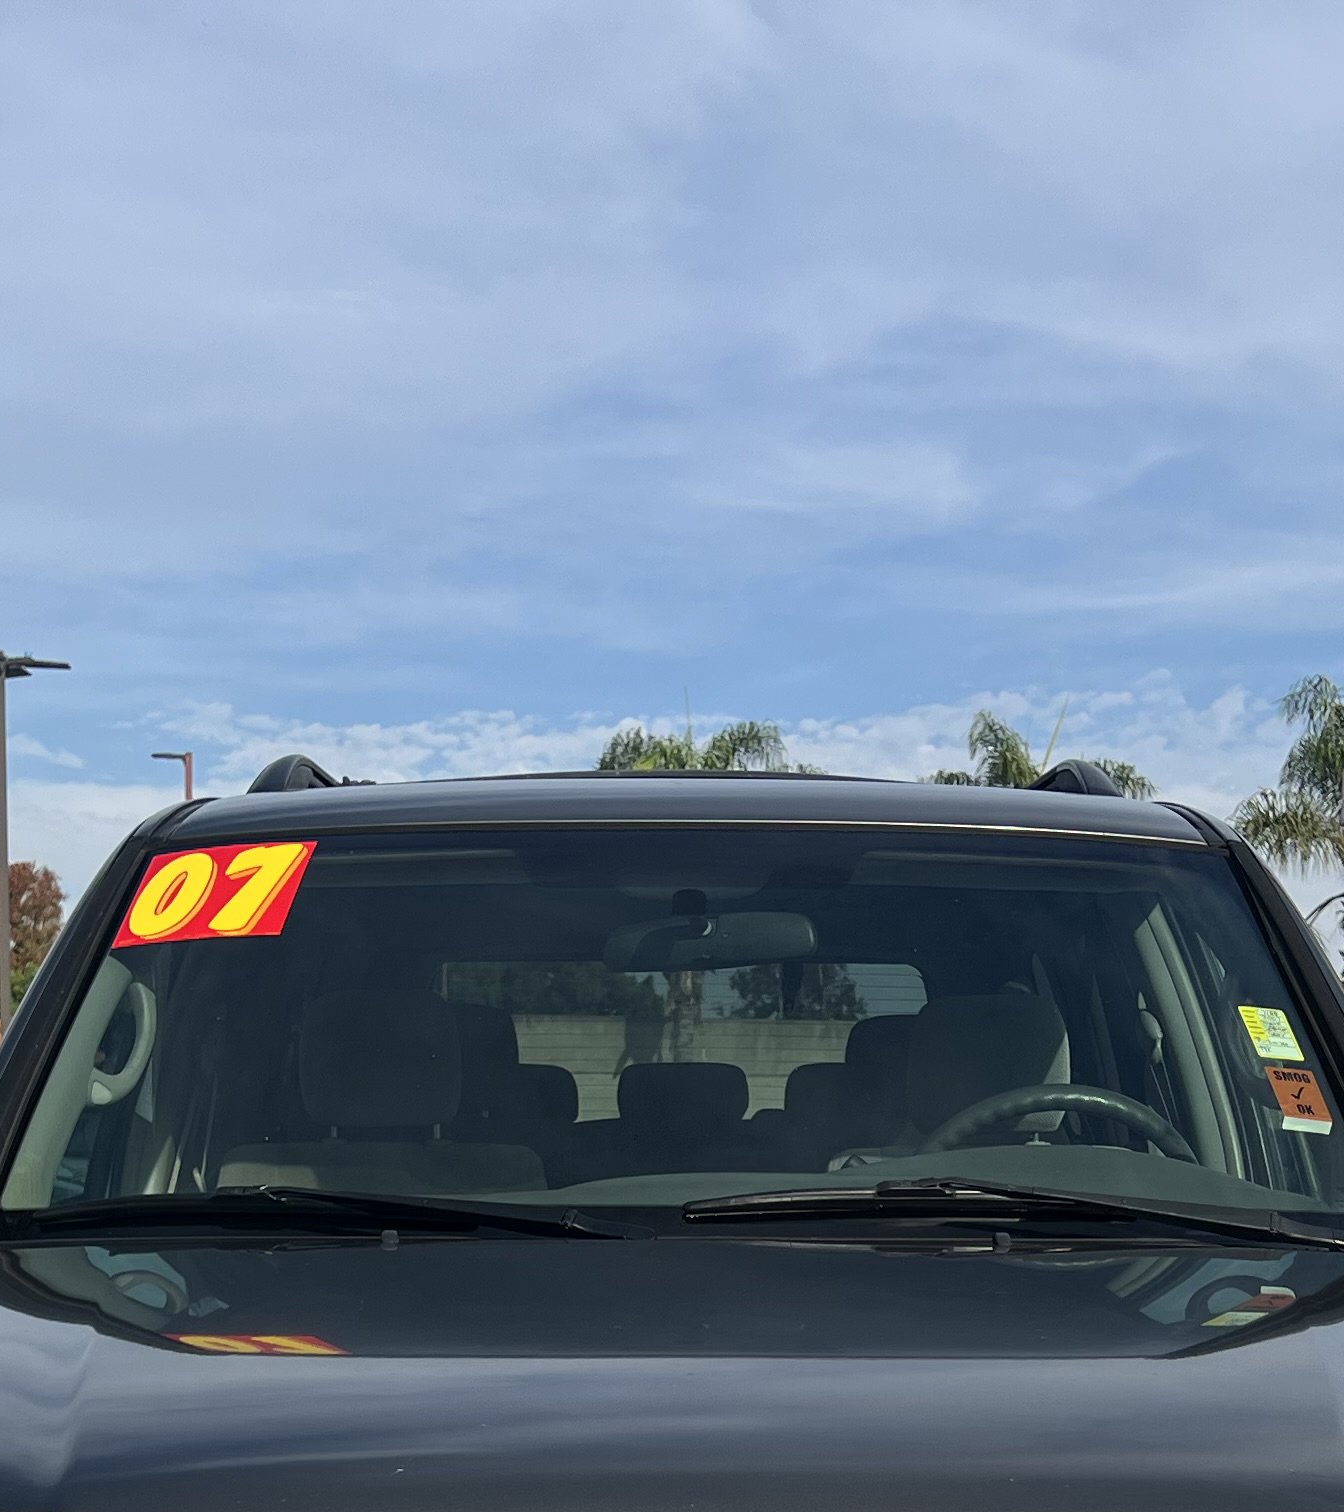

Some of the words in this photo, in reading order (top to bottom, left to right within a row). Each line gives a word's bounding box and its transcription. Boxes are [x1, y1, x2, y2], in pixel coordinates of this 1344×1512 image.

[129, 843, 308, 940] 07
[1273, 1070, 1311, 1084] SMOG
[1297, 1104, 1315, 1115] OK
